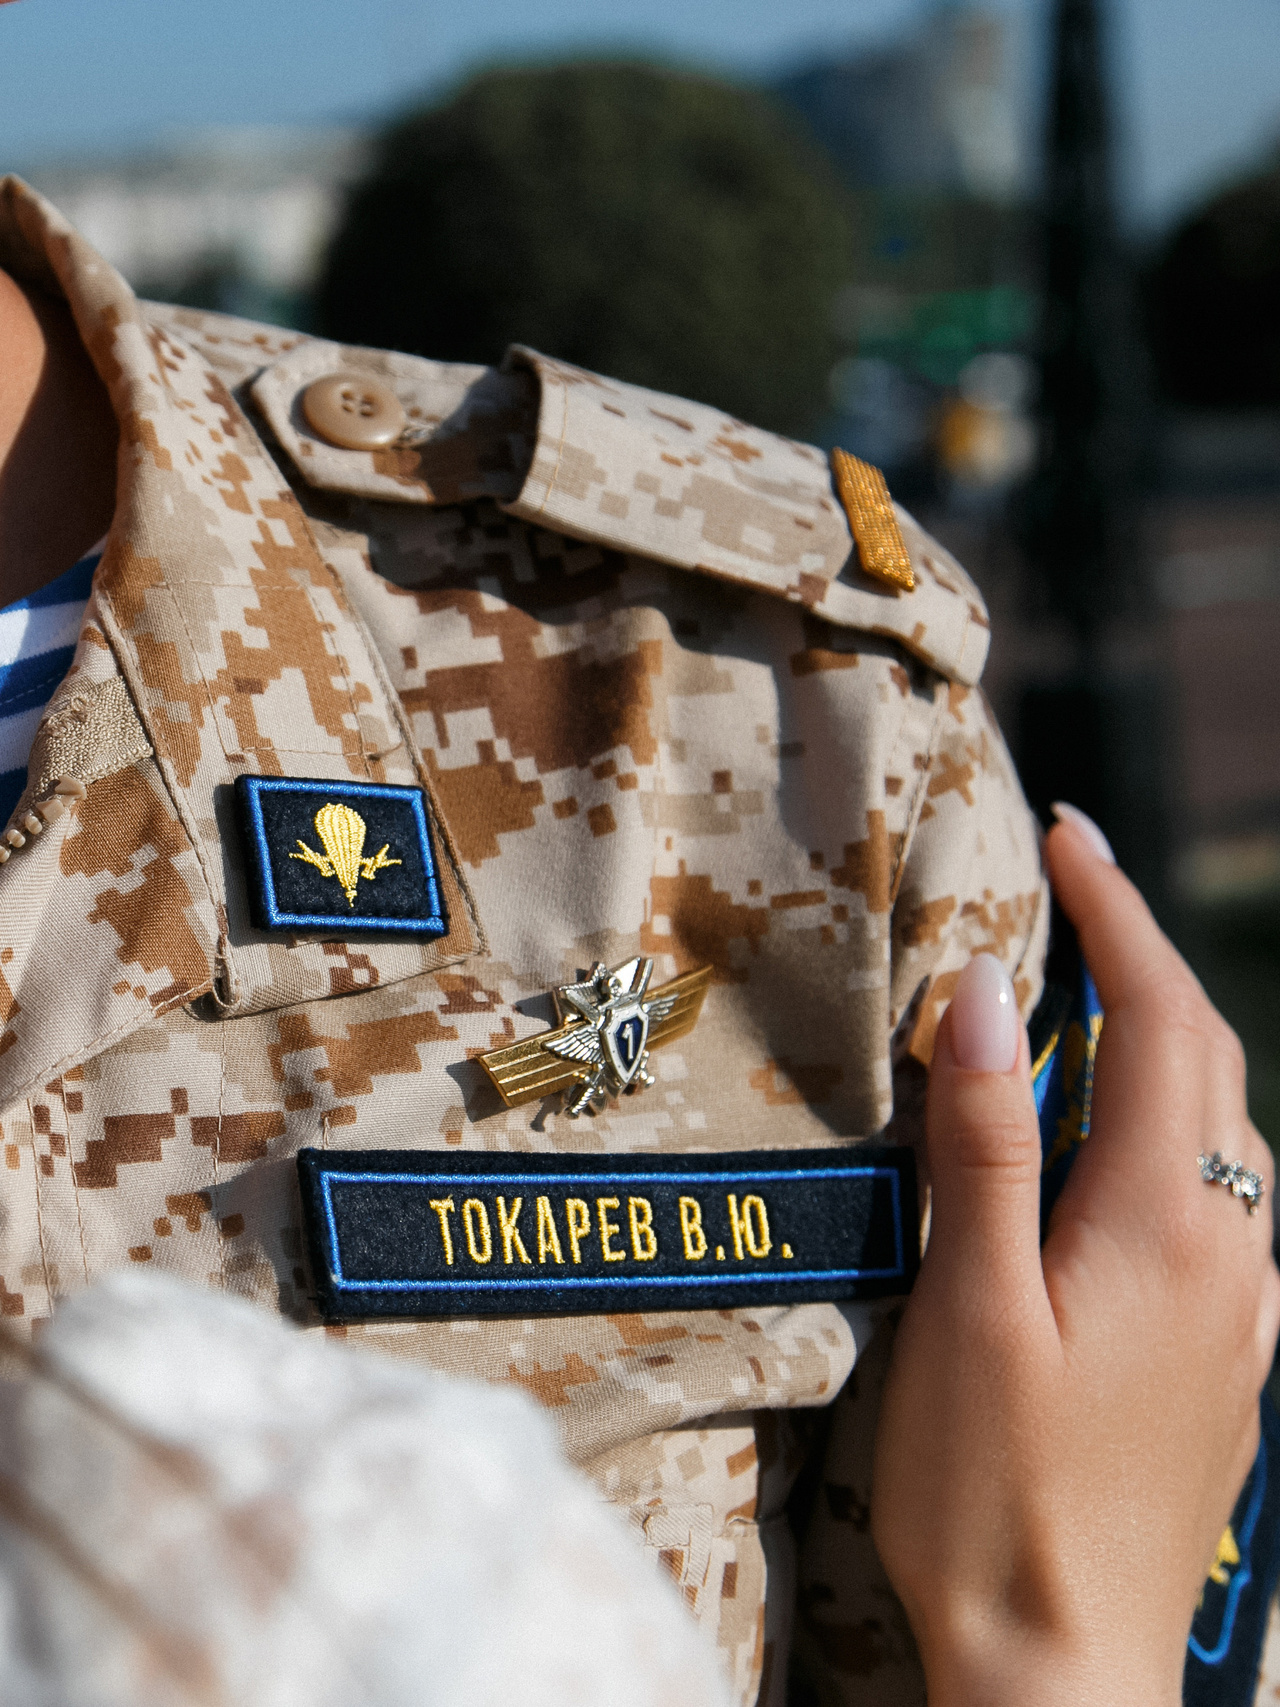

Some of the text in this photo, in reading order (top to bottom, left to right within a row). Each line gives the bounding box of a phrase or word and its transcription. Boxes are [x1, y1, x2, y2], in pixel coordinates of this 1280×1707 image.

[622, 1023, 634, 1060] 1
[429, 1194, 795, 1265] ТОКАРЕВ В.Ю.
